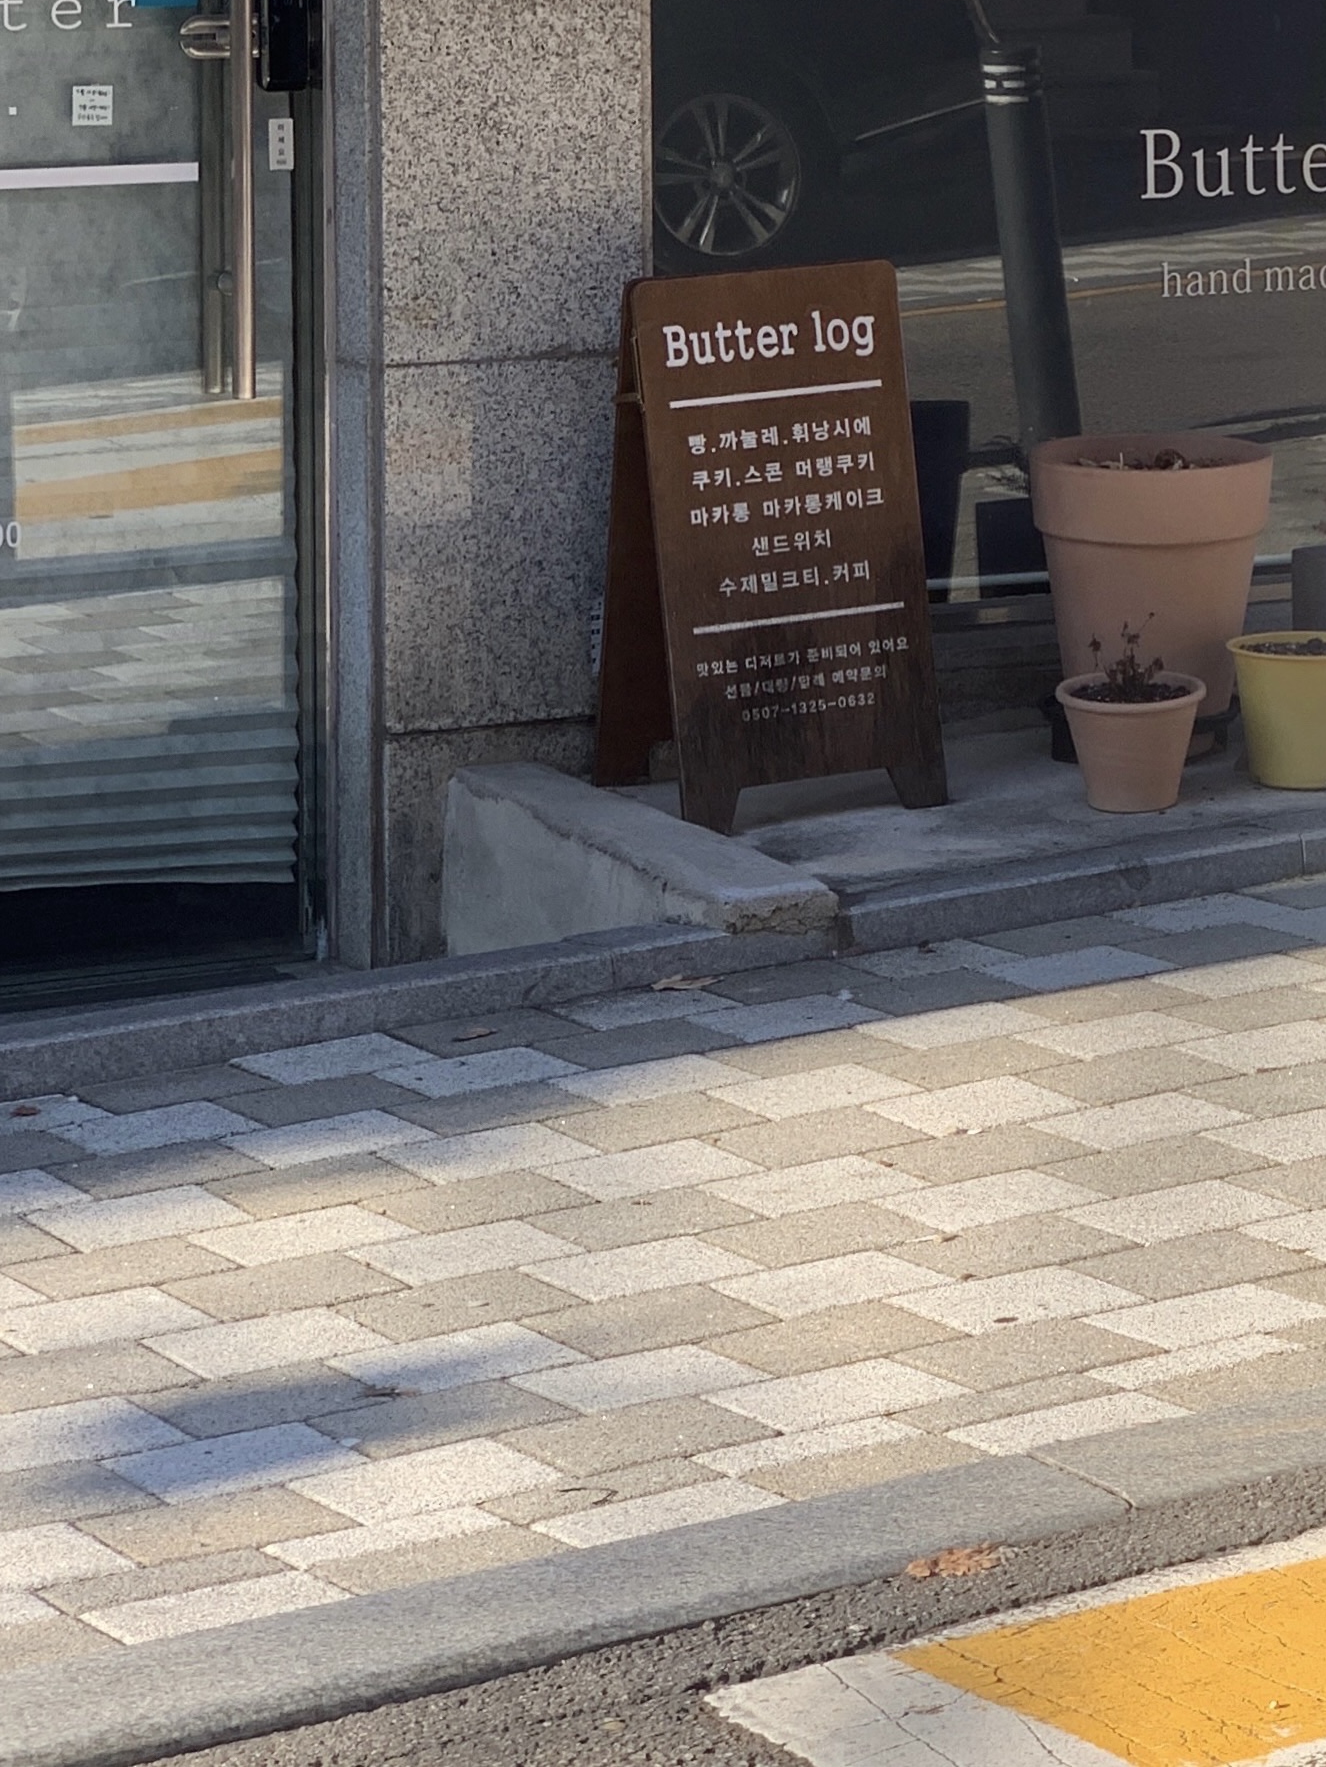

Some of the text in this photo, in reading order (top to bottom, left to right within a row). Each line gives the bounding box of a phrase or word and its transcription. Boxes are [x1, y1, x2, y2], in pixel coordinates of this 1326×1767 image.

[1161, 258, 1252, 298] hand
[662, 310, 876, 368] Butter log
[795, 451, 876, 479] 머랭쿠키
[690, 487, 885, 528] 마카롱 마카롱케이크
[751, 528, 832, 557] 샌드위치
[696, 635, 909, 678] 맛있는 디저트가 준비되어 있어요
[831, 663, 887, 684] 예약문의
[741, 691, 876, 722] 0507-1325-0632
